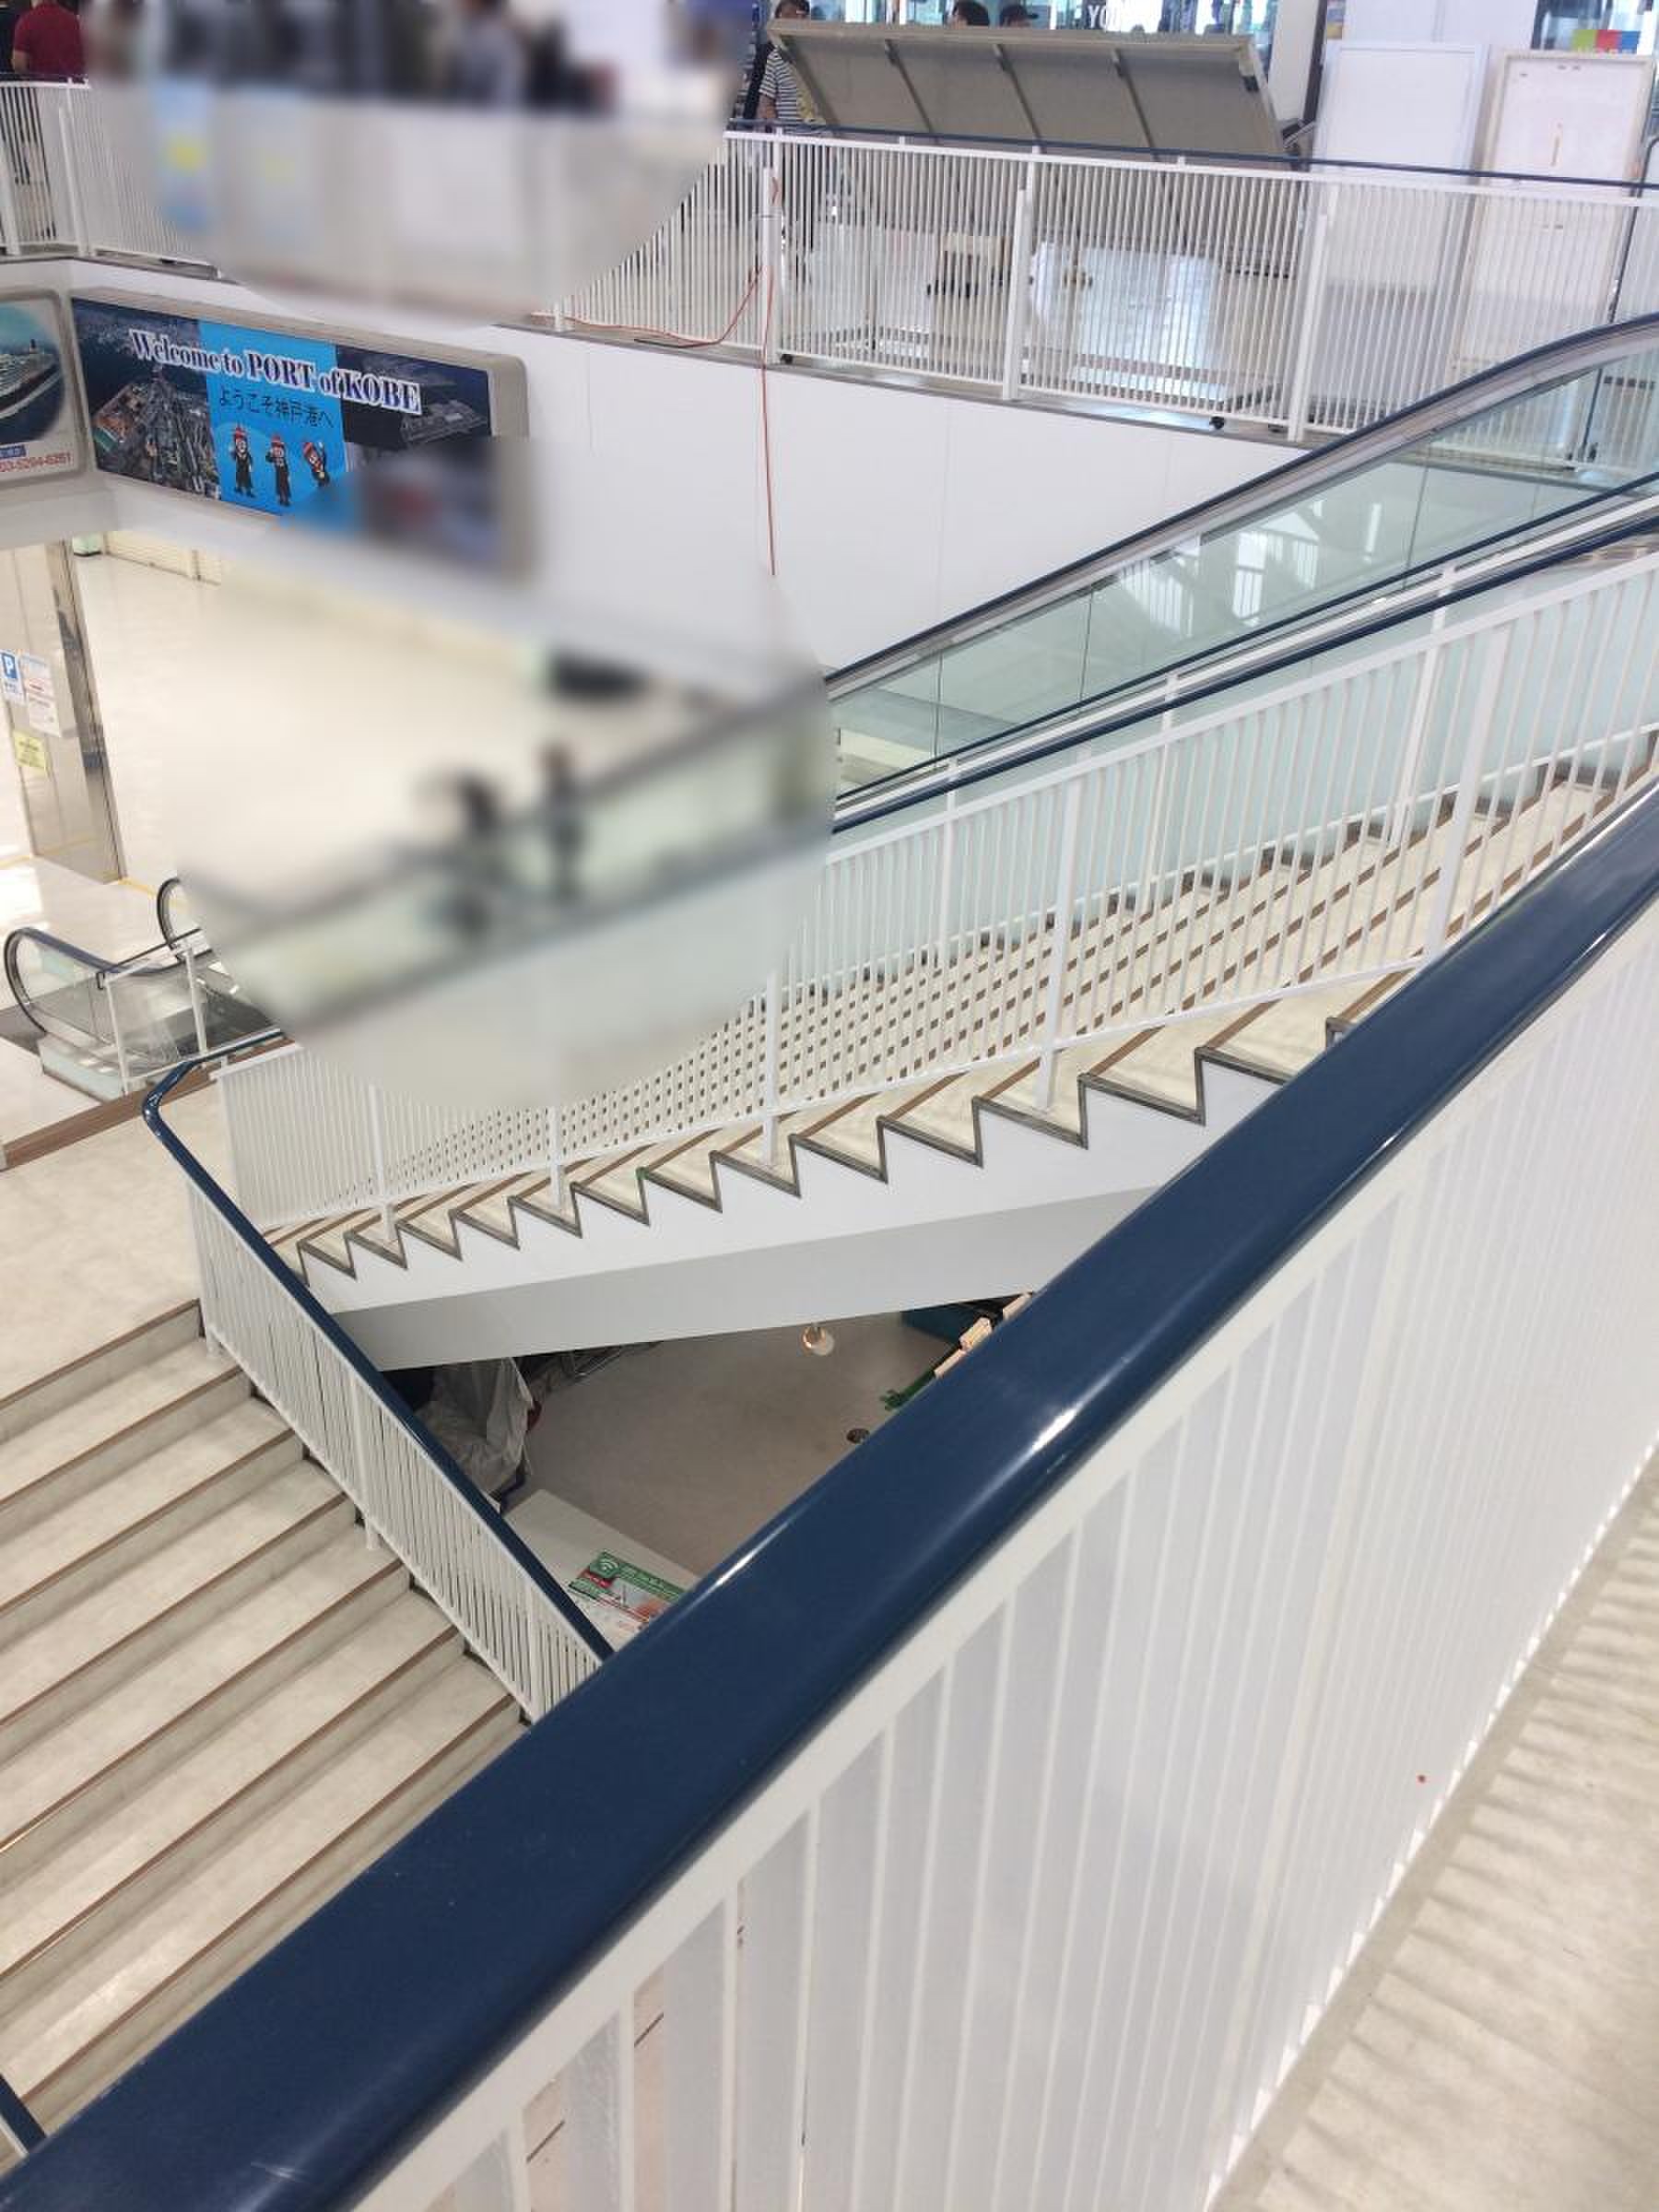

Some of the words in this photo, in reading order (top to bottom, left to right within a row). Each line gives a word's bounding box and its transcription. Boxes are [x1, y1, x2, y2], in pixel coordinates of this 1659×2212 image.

[130, 329, 219, 372] Welcome
[221, 347, 244, 378] to
[244, 350, 315, 392] PORT
[318, 367, 341, 398] of
[341, 369, 422, 415] KOBE
[219, 385, 335, 428] ようこそ神戸港へ
